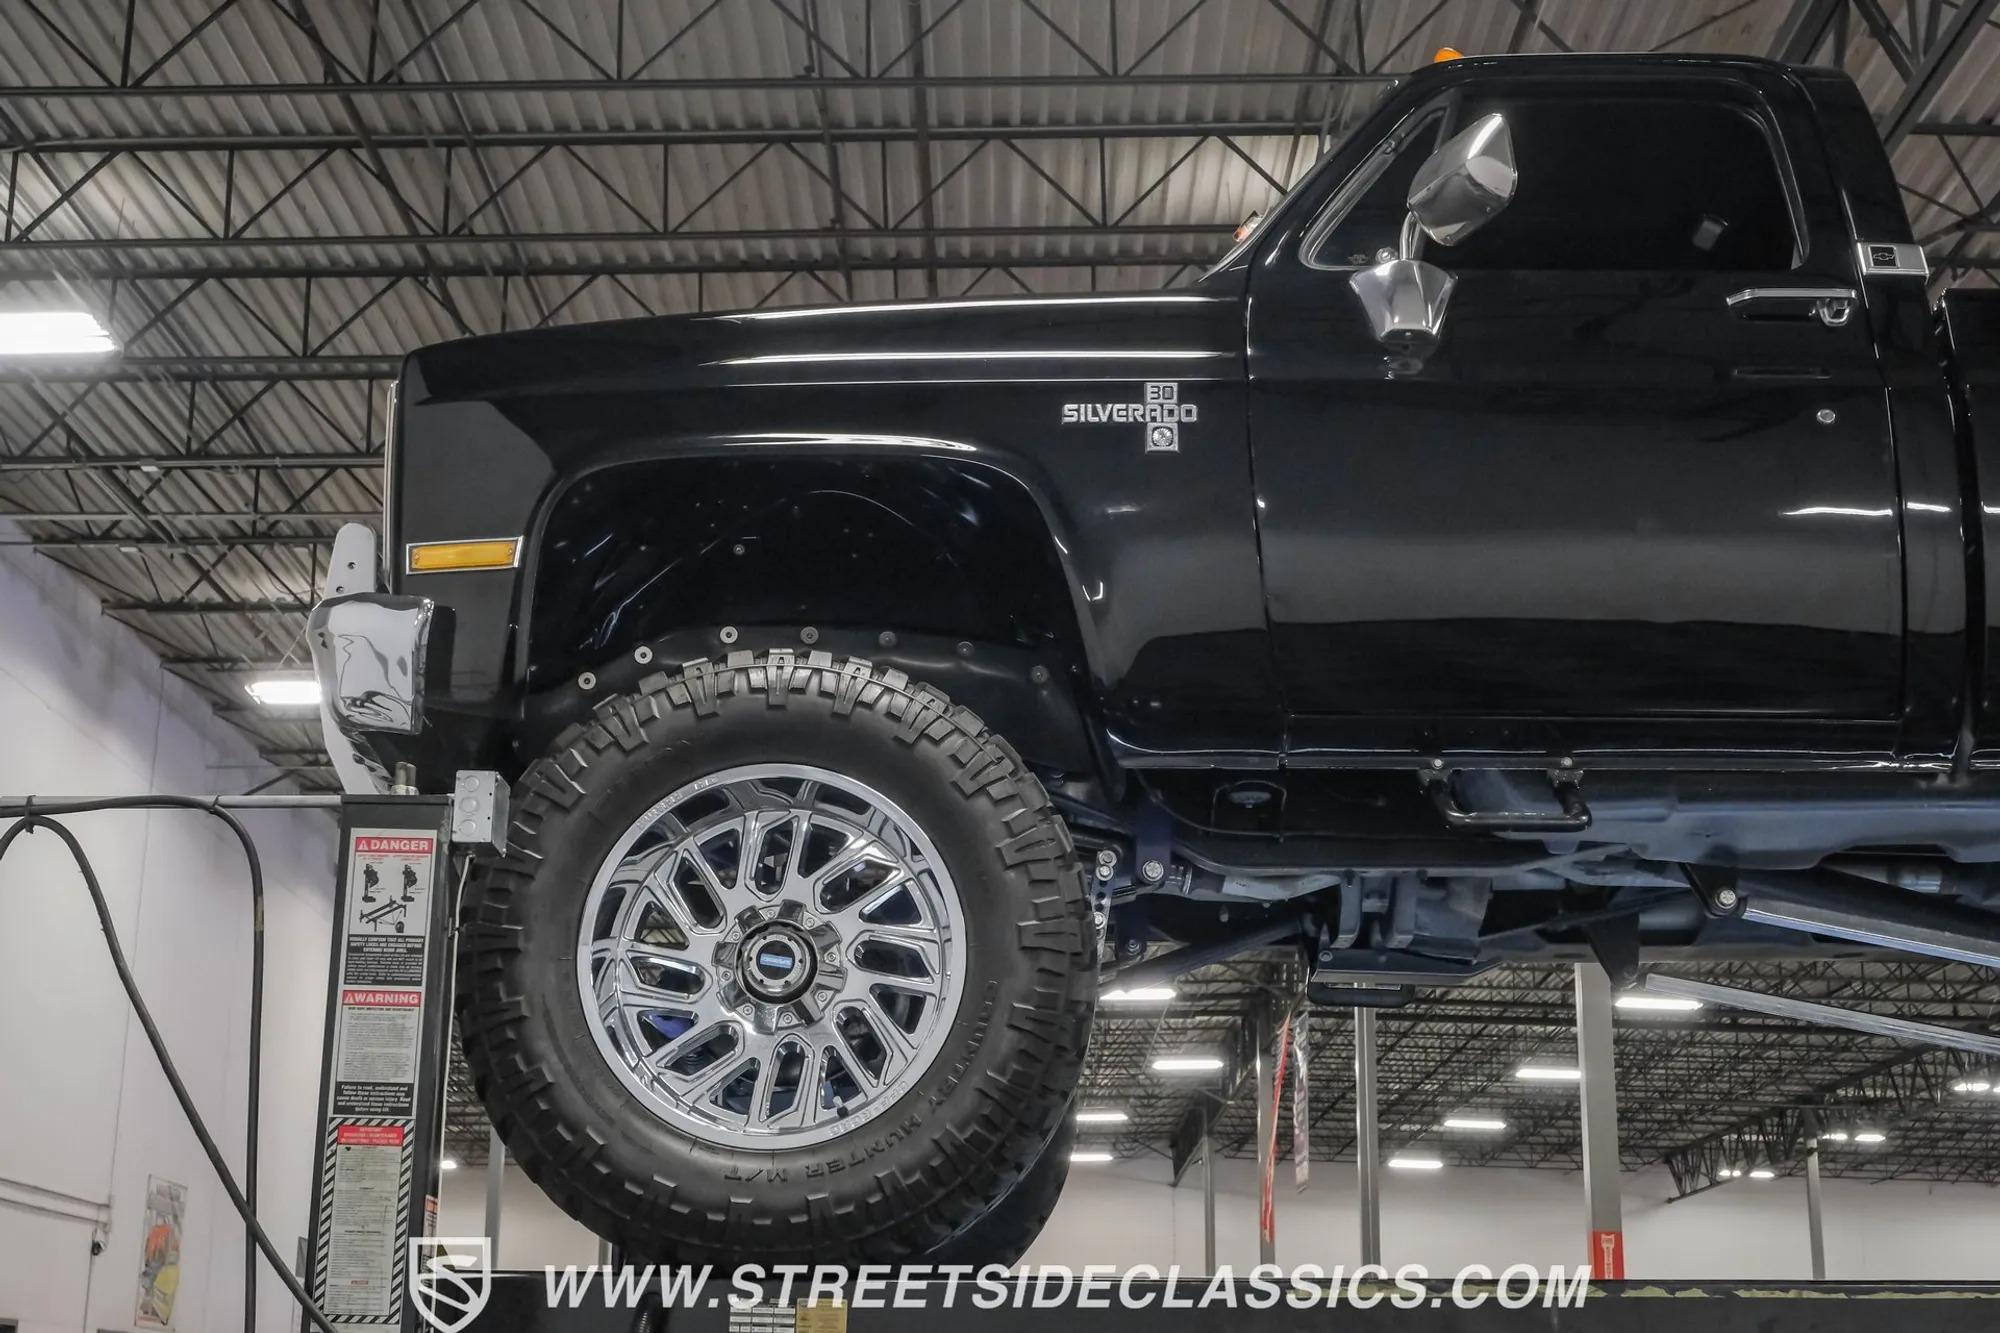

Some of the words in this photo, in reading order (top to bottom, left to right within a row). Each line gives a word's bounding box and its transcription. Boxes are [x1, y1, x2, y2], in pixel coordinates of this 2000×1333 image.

[1150, 385, 1174, 400] 30
[1062, 403, 1197, 423] SILVERADO
[370, 840, 429, 851] DANGER
[353, 992, 419, 1004] WARNING
[724, 1168, 788, 1183] M/T
